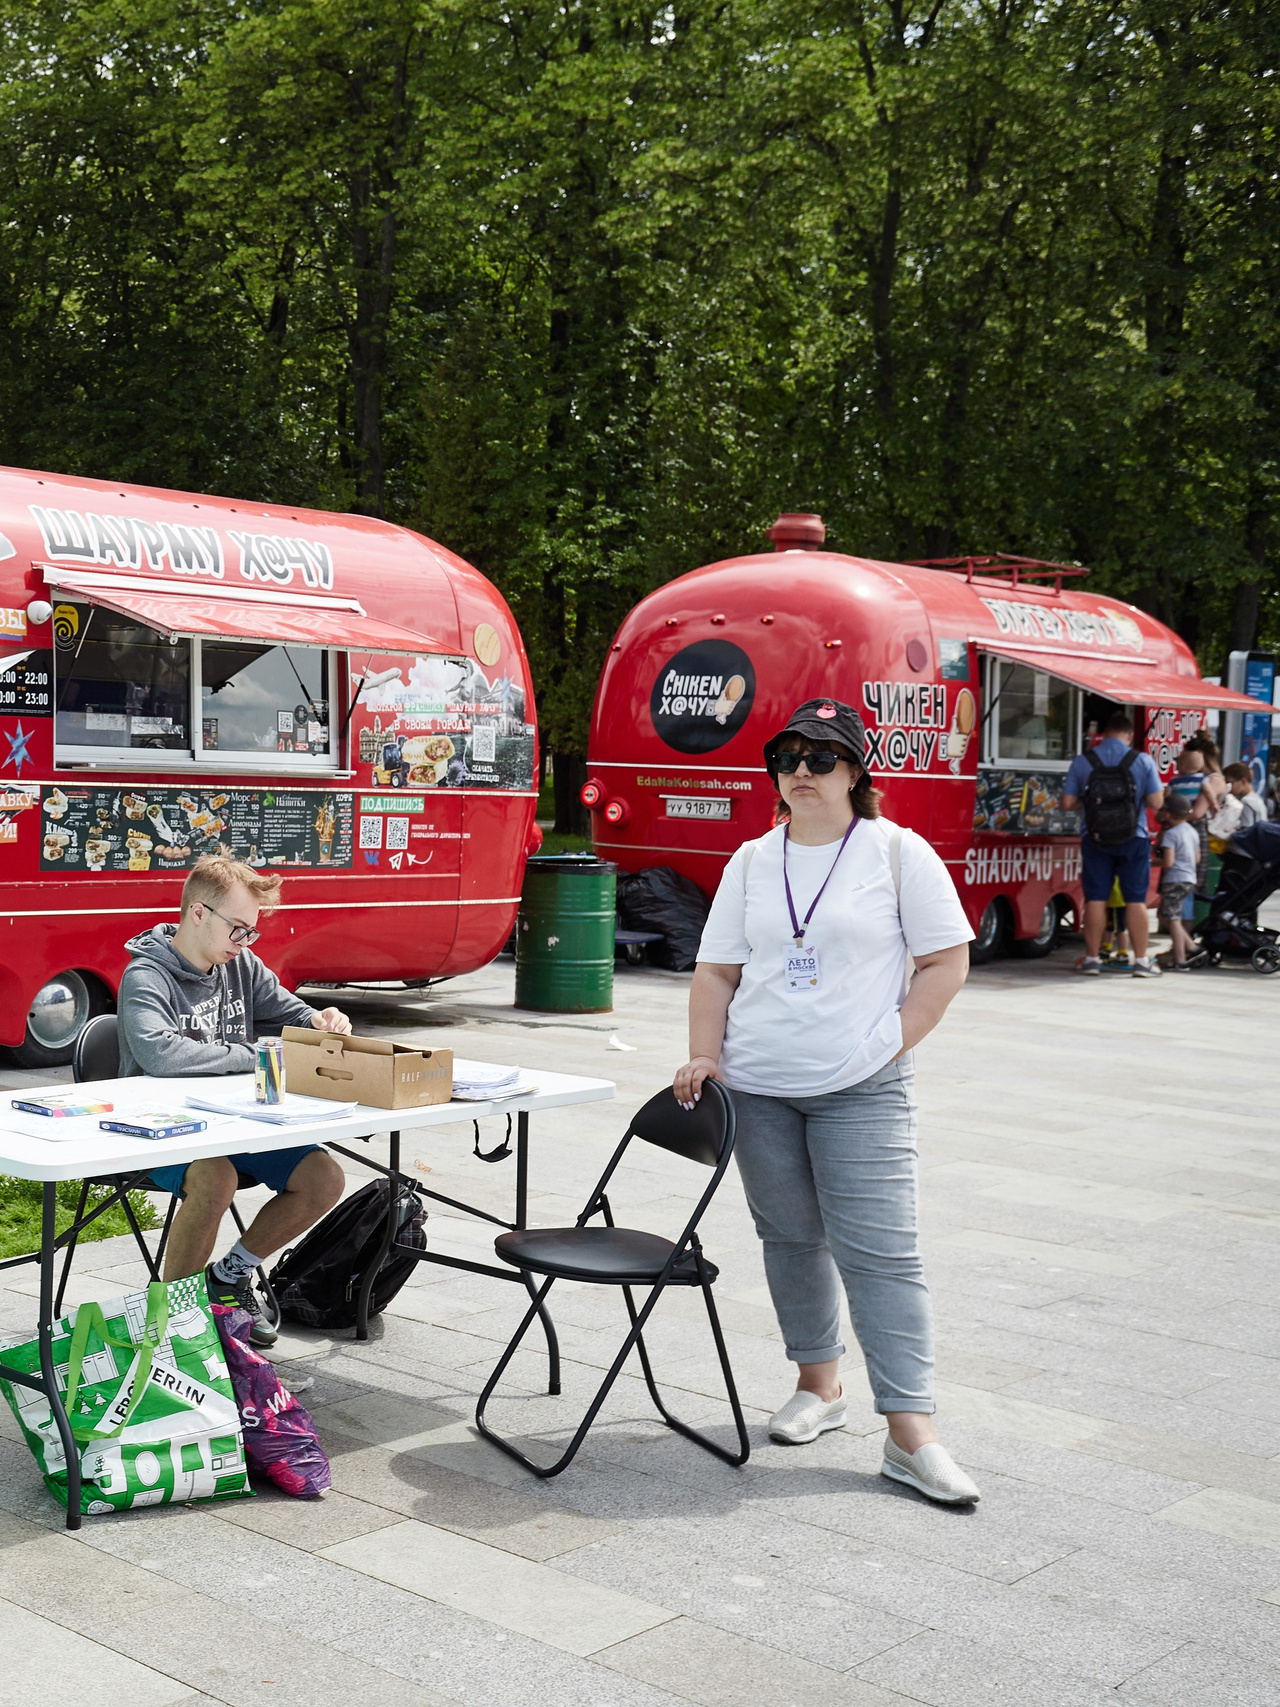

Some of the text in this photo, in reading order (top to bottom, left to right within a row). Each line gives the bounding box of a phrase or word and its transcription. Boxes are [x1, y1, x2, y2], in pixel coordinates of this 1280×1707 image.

[28, 504, 334, 590] ШАУРМУ Х@ЧУ
[24, 672, 48, 685] 22:00
[663, 669, 723, 696] CHIKEN
[25, 692, 49, 705] 23:00
[659, 696, 708, 716] Х@ЧУ
[863, 681, 946, 729] ЧИКЕН
[864, 728, 937, 770] Х@ЧУ
[637, 776, 751, 791] EdaNaKolesah.com
[231, 792, 251, 803] Морс
[361, 797, 424, 812] ПОДПИШИСЬ
[686, 802, 712, 814] 9187
[716, 803, 727, 812] 77
[788, 958, 816, 966] ЛЕТО
[151, 1364, 205, 1406] ERLIN
